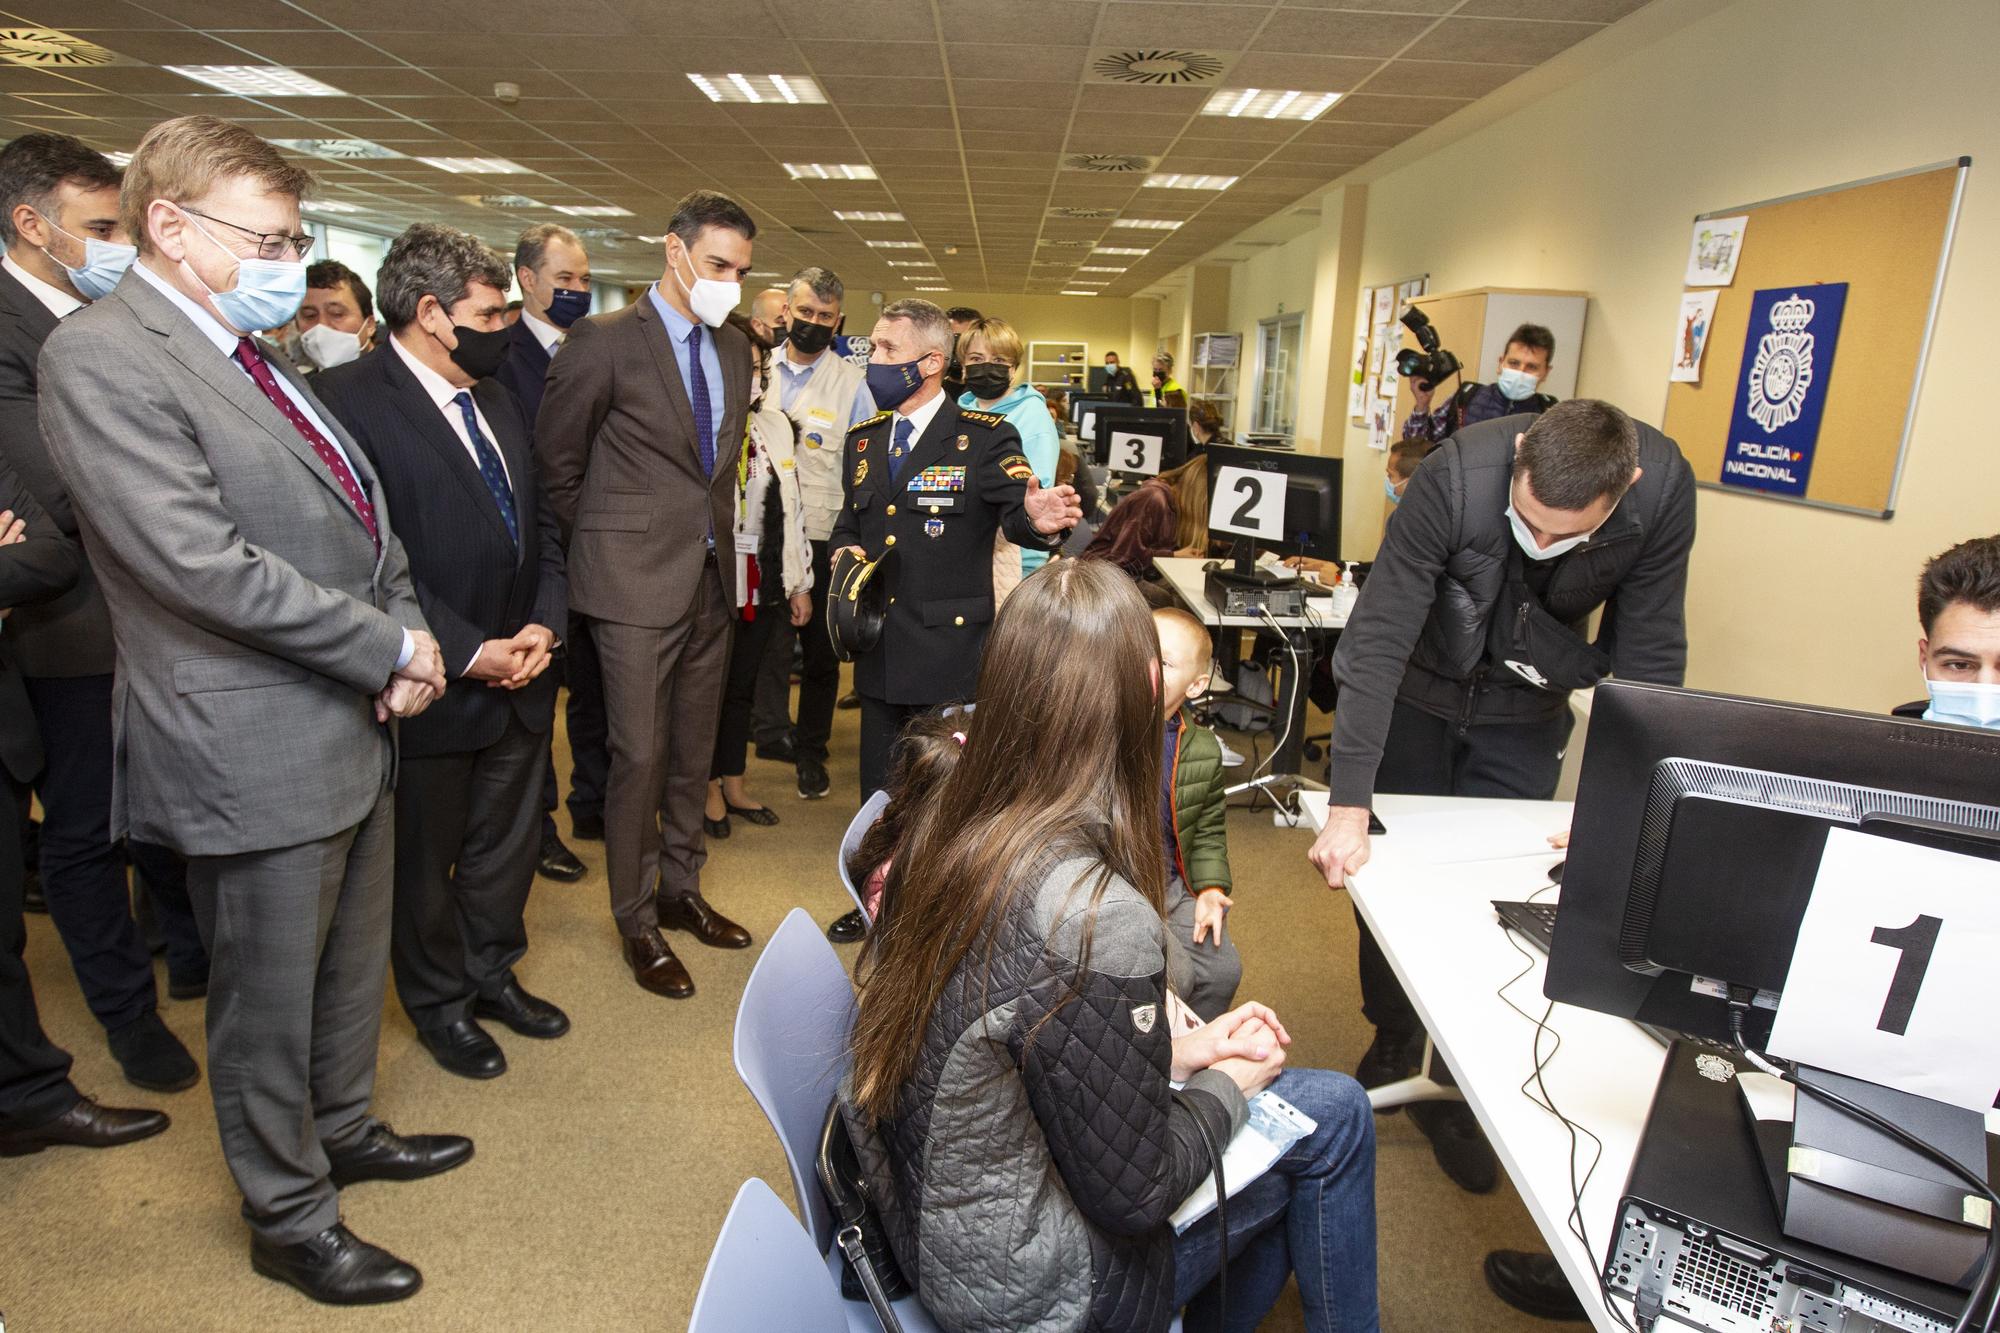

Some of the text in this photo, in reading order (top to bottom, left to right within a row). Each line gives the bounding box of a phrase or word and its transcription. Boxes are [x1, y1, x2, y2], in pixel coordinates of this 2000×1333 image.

[1124, 438, 1146, 469] 3
[1725, 460, 1797, 483] NACIONAL
[1229, 476, 1263, 530] 2
[1870, 913, 1944, 1037] 1
